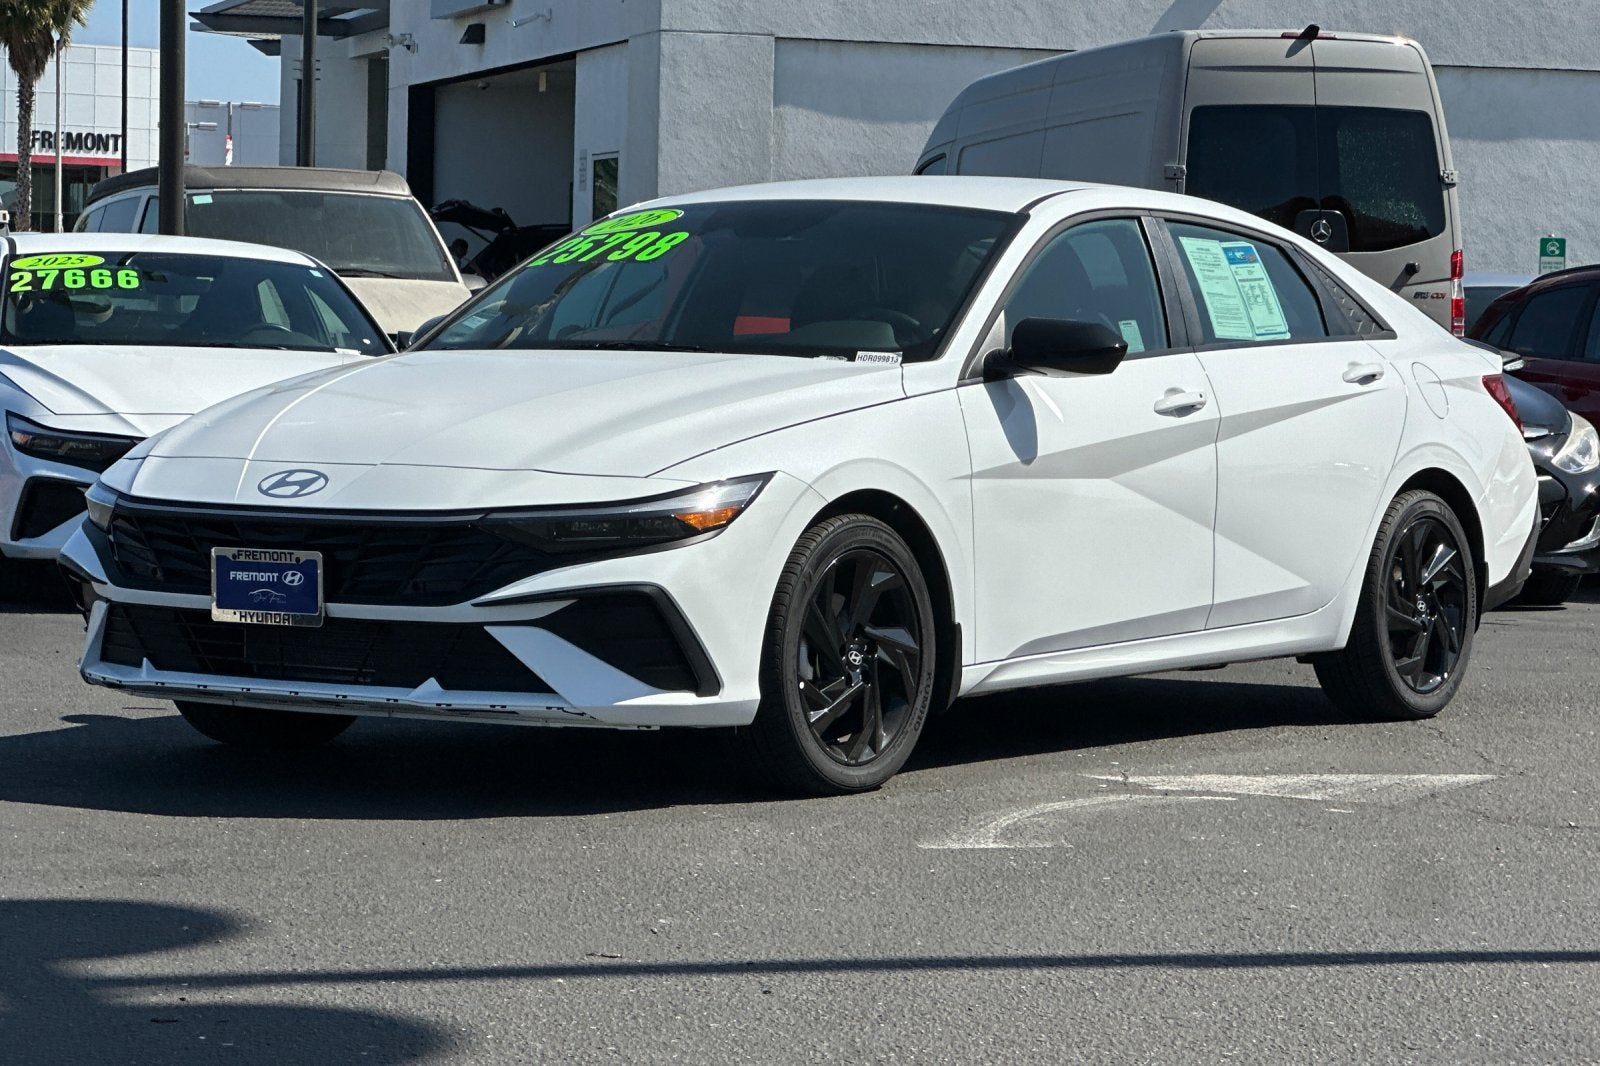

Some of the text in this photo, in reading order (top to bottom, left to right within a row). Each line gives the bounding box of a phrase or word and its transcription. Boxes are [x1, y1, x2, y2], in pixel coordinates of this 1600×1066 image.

[527, 231, 690, 267] 25798
[25, 256, 89, 267] 2025
[10, 269, 140, 292] 27666
[857, 354, 899, 363] HDR099813
[236, 549, 295, 562] FREMONT
[229, 571, 279, 582] FREMONT
[914, 672, 932, 732] KUMHO
